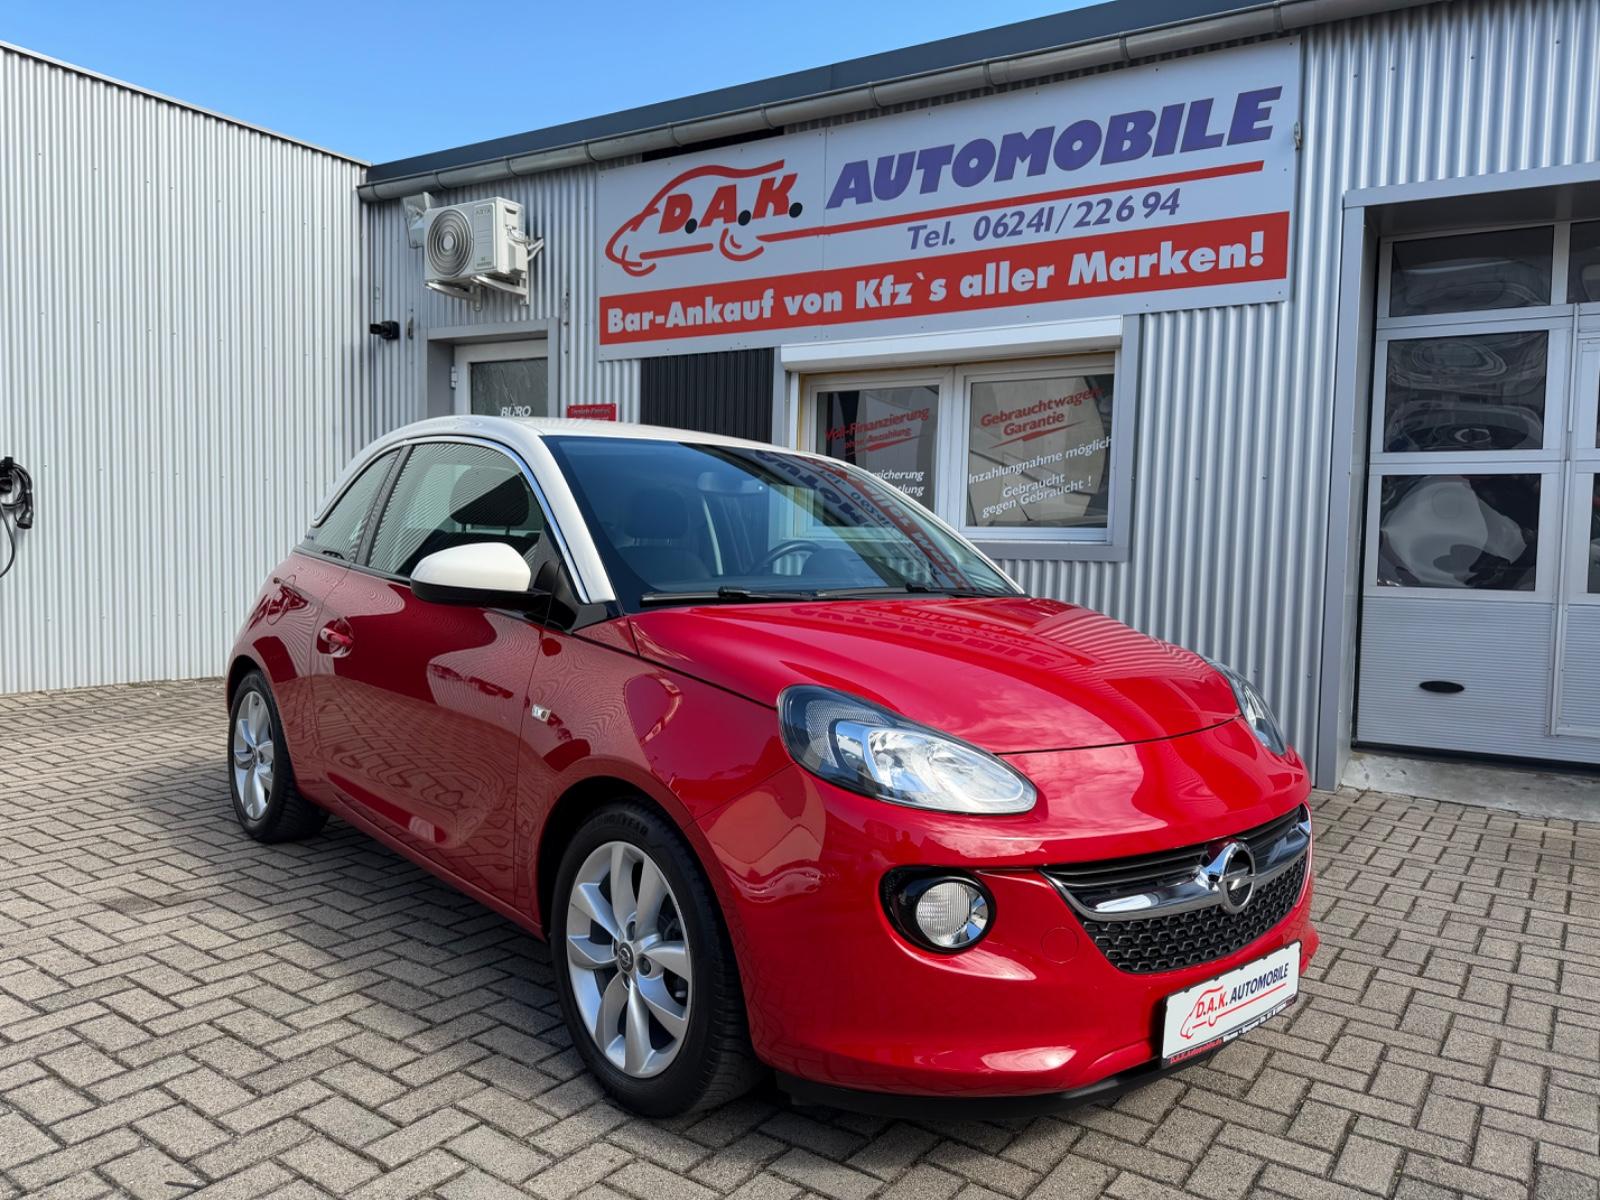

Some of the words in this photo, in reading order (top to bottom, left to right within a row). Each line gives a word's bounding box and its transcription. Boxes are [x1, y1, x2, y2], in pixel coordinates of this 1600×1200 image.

[658, 173, 803, 234] D.A.K.
[825, 86, 1283, 209] AUTOMOBILE
[907, 221, 956, 251] Tel.
[607, 288, 774, 334] Bar-Ankauf
[783, 290, 843, 316] von
[959, 260, 1055, 298] aller
[1067, 231, 1265, 286] Marken!
[501, 403, 532, 417] BÜRO
[1003, 411, 1065, 436] Garantie
[968, 454, 1063, 485] Inzahlungnahme
[982, 500, 1017, 518] gegen
[1020, 480, 1084, 505] Gebraucht
[1002, 473, 1065, 498] Gebraucht
[1195, 991, 1228, 1019] D.A.K.
[1229, 962, 1290, 1004] AUTOMOBILE
